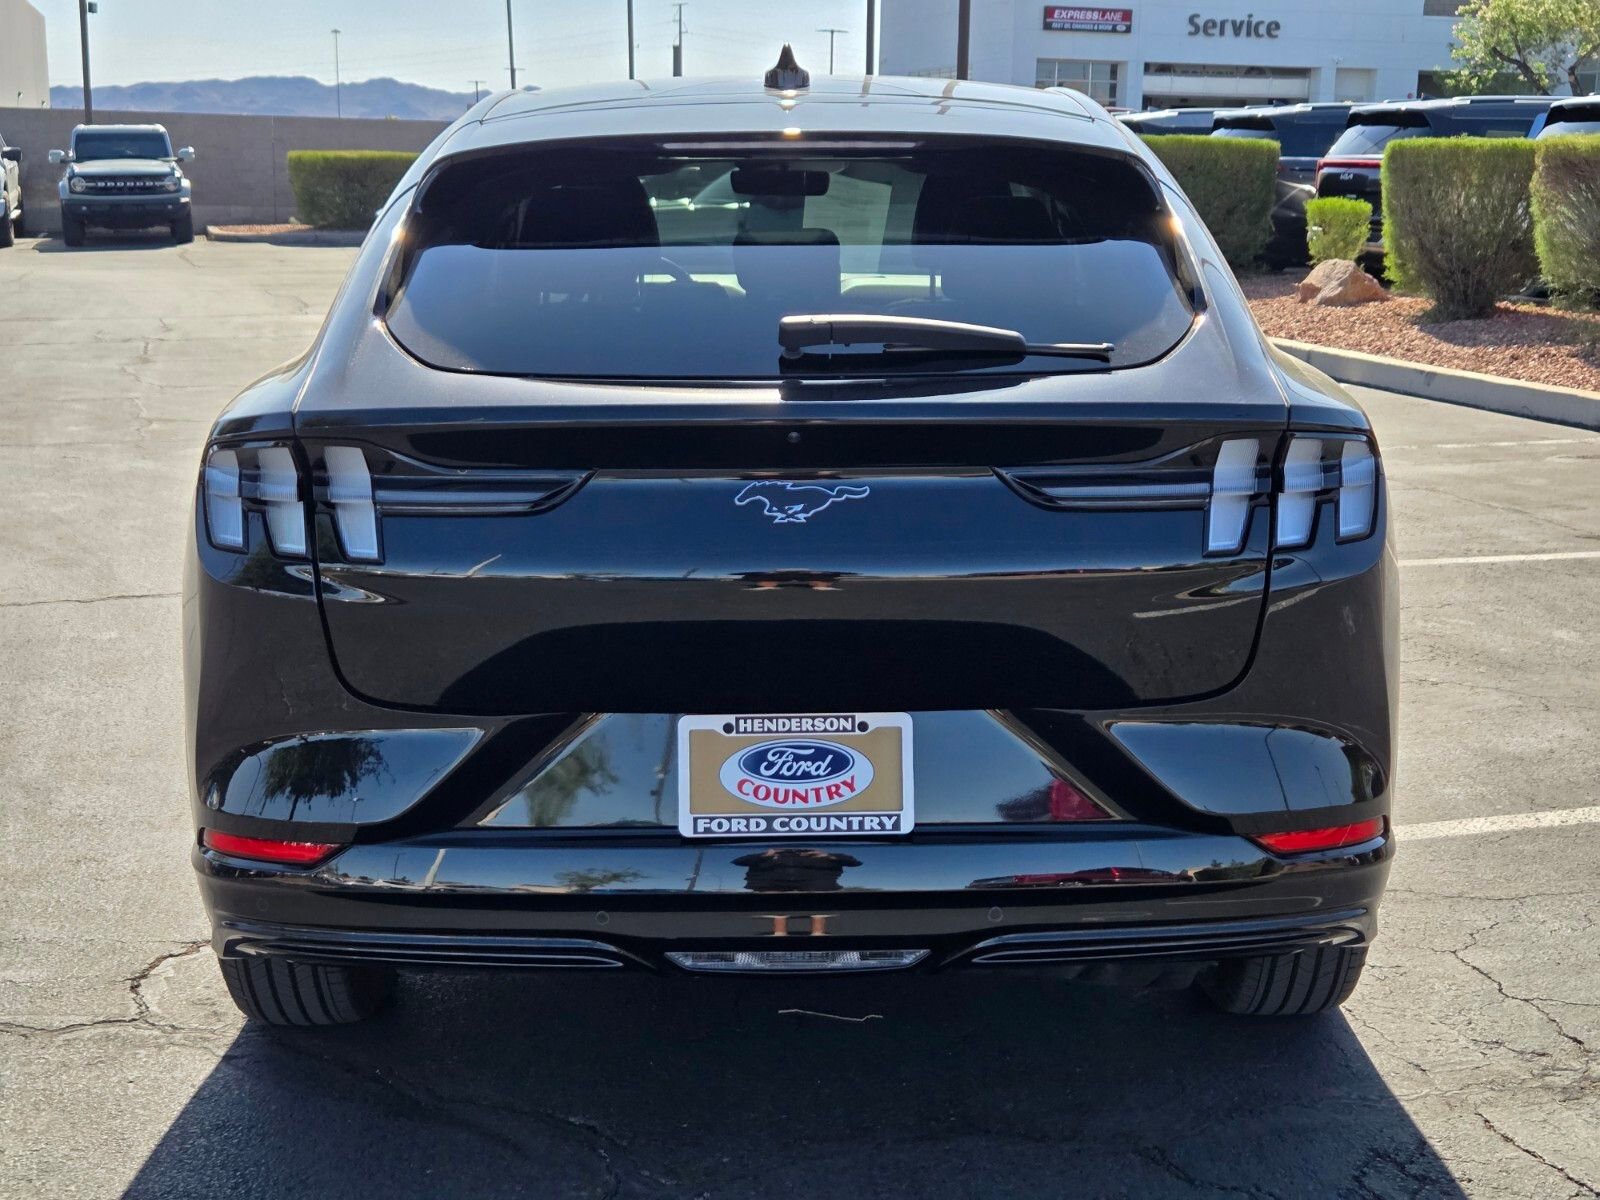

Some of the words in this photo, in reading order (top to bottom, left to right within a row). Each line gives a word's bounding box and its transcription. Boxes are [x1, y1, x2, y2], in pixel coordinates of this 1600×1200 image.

[1187, 13, 1281, 38] Service
[739, 717, 853, 732] HENDERSON
[759, 747, 833, 777] Ford
[737, 775, 857, 804] COUNTRY
[697, 817, 767, 833] FORD
[773, 816, 898, 831] COUNTRY
